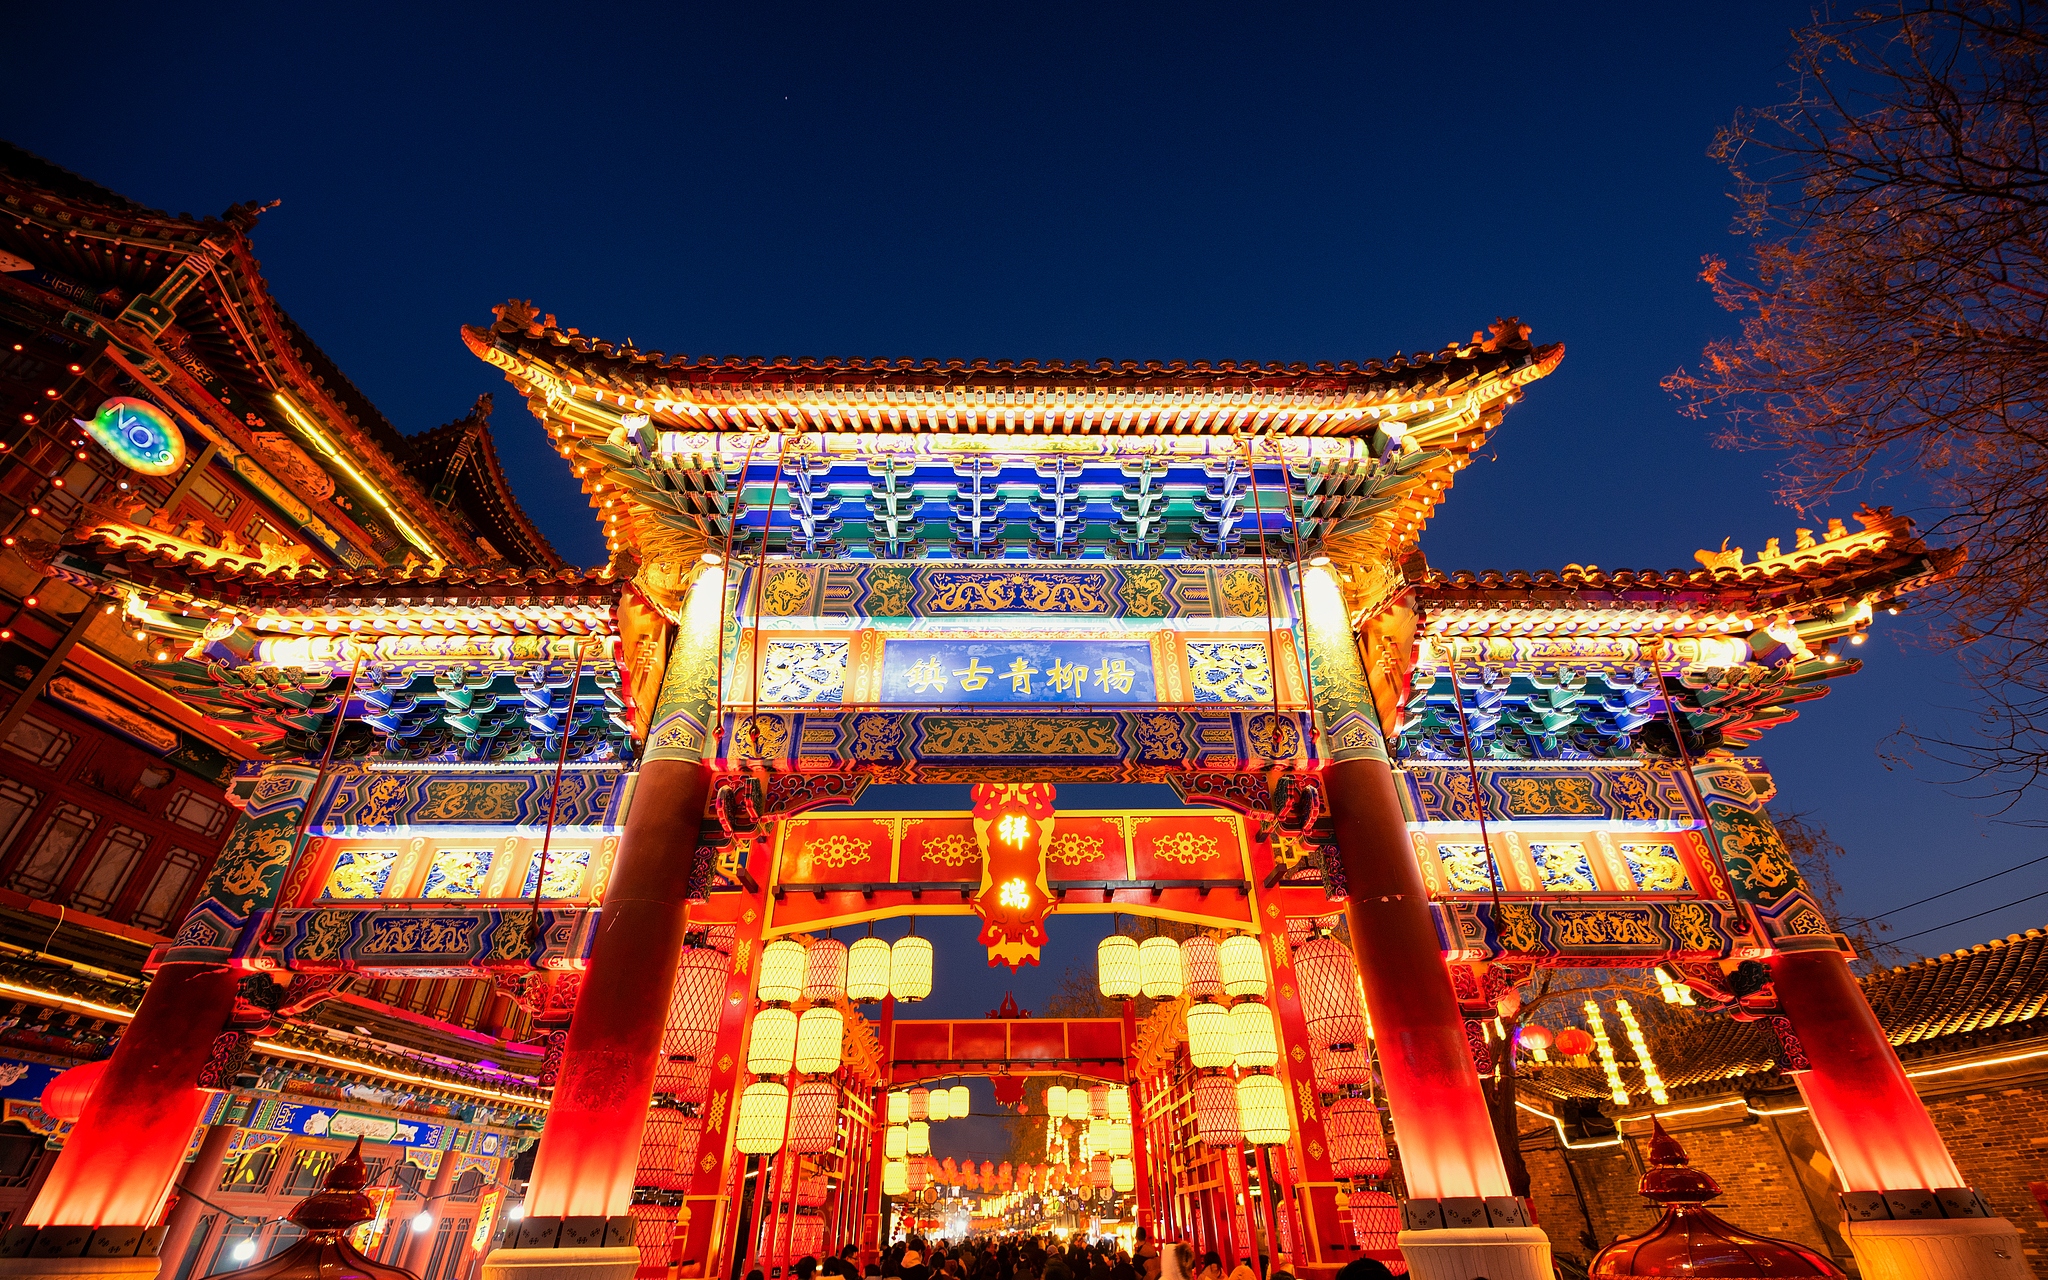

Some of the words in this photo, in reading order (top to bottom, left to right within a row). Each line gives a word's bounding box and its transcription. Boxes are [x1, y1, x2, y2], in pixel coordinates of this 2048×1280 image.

[903, 656, 1136, 698] 楊柳青古鎮
[999, 815, 1031, 909] 祥瑞
